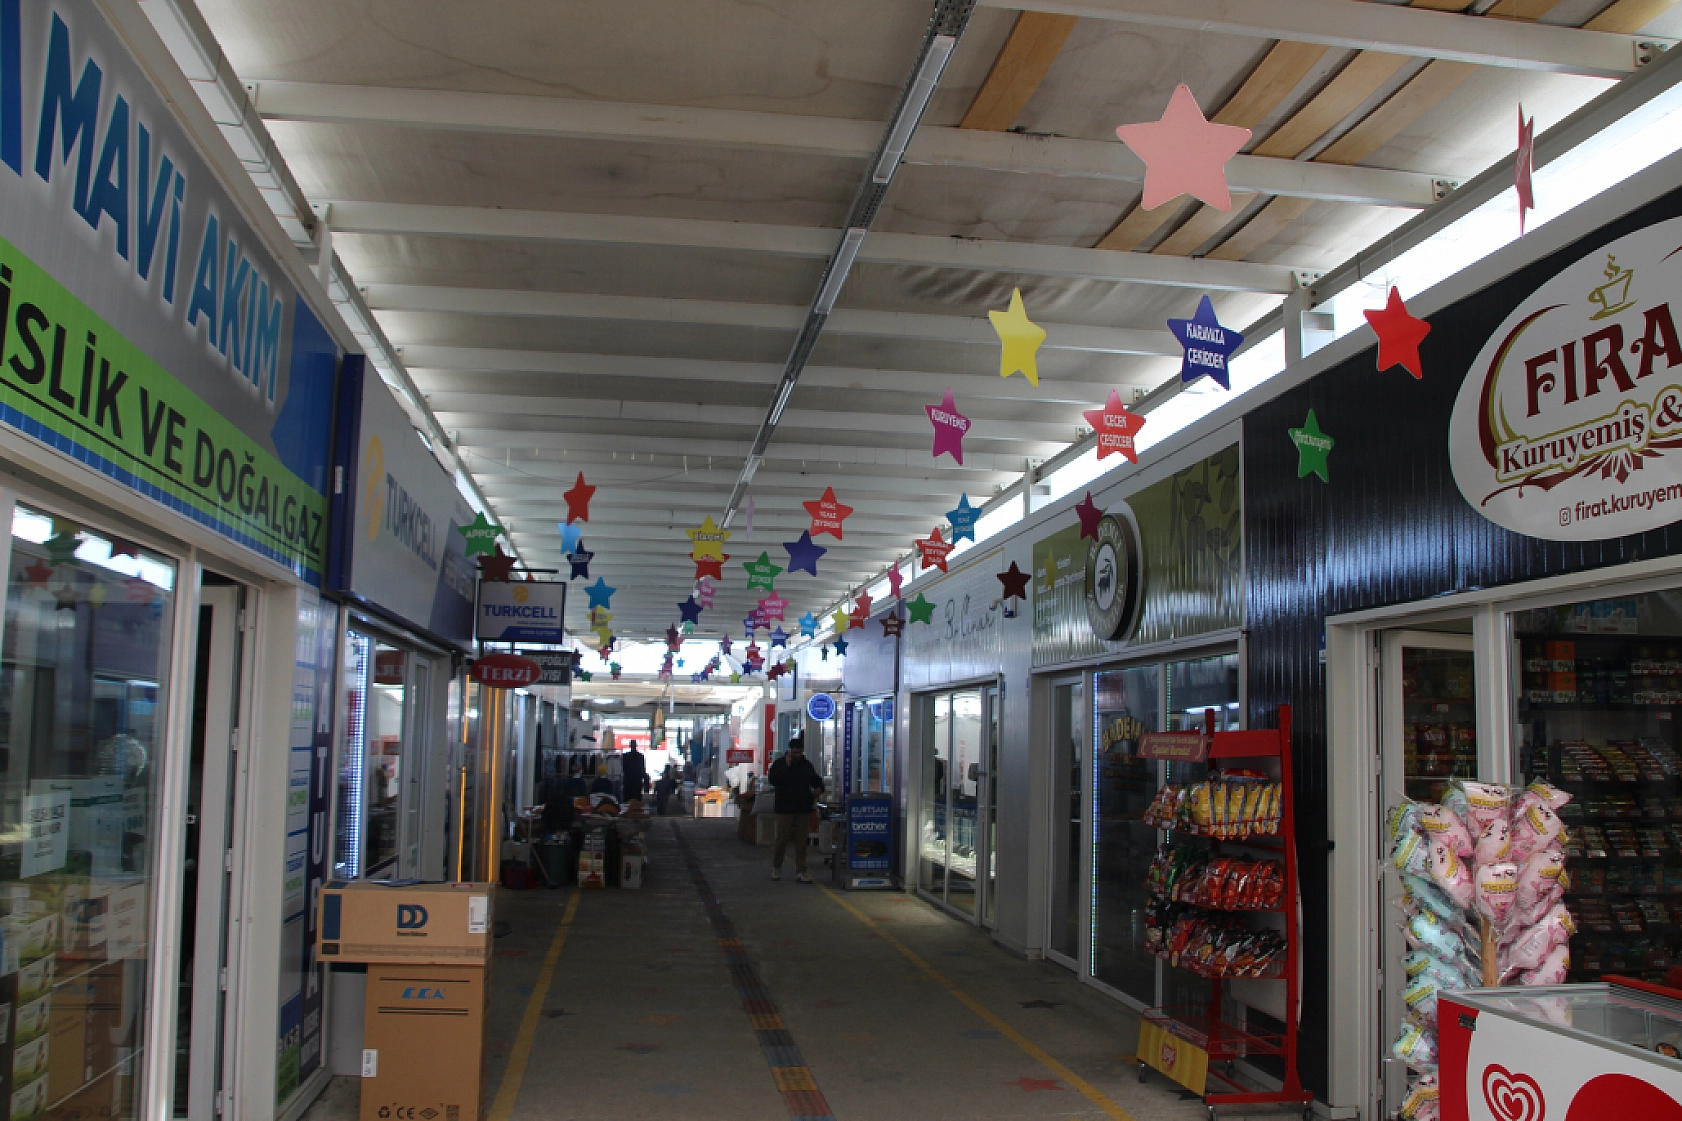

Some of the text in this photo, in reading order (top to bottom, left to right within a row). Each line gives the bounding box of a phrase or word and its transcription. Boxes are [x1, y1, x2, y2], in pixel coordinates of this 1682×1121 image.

[187, 213, 282, 403] AKIM
[139, 386, 187, 474] VE
[194, 428, 322, 556] DOĞALGAZ
[1503, 410, 1644, 474] Kuruyemiş
[386, 471, 437, 572] TURKCELL
[465, 529, 496, 539] APPLE
[483, 604, 557, 619] TURKCELL
[851, 821, 888, 831] brother
